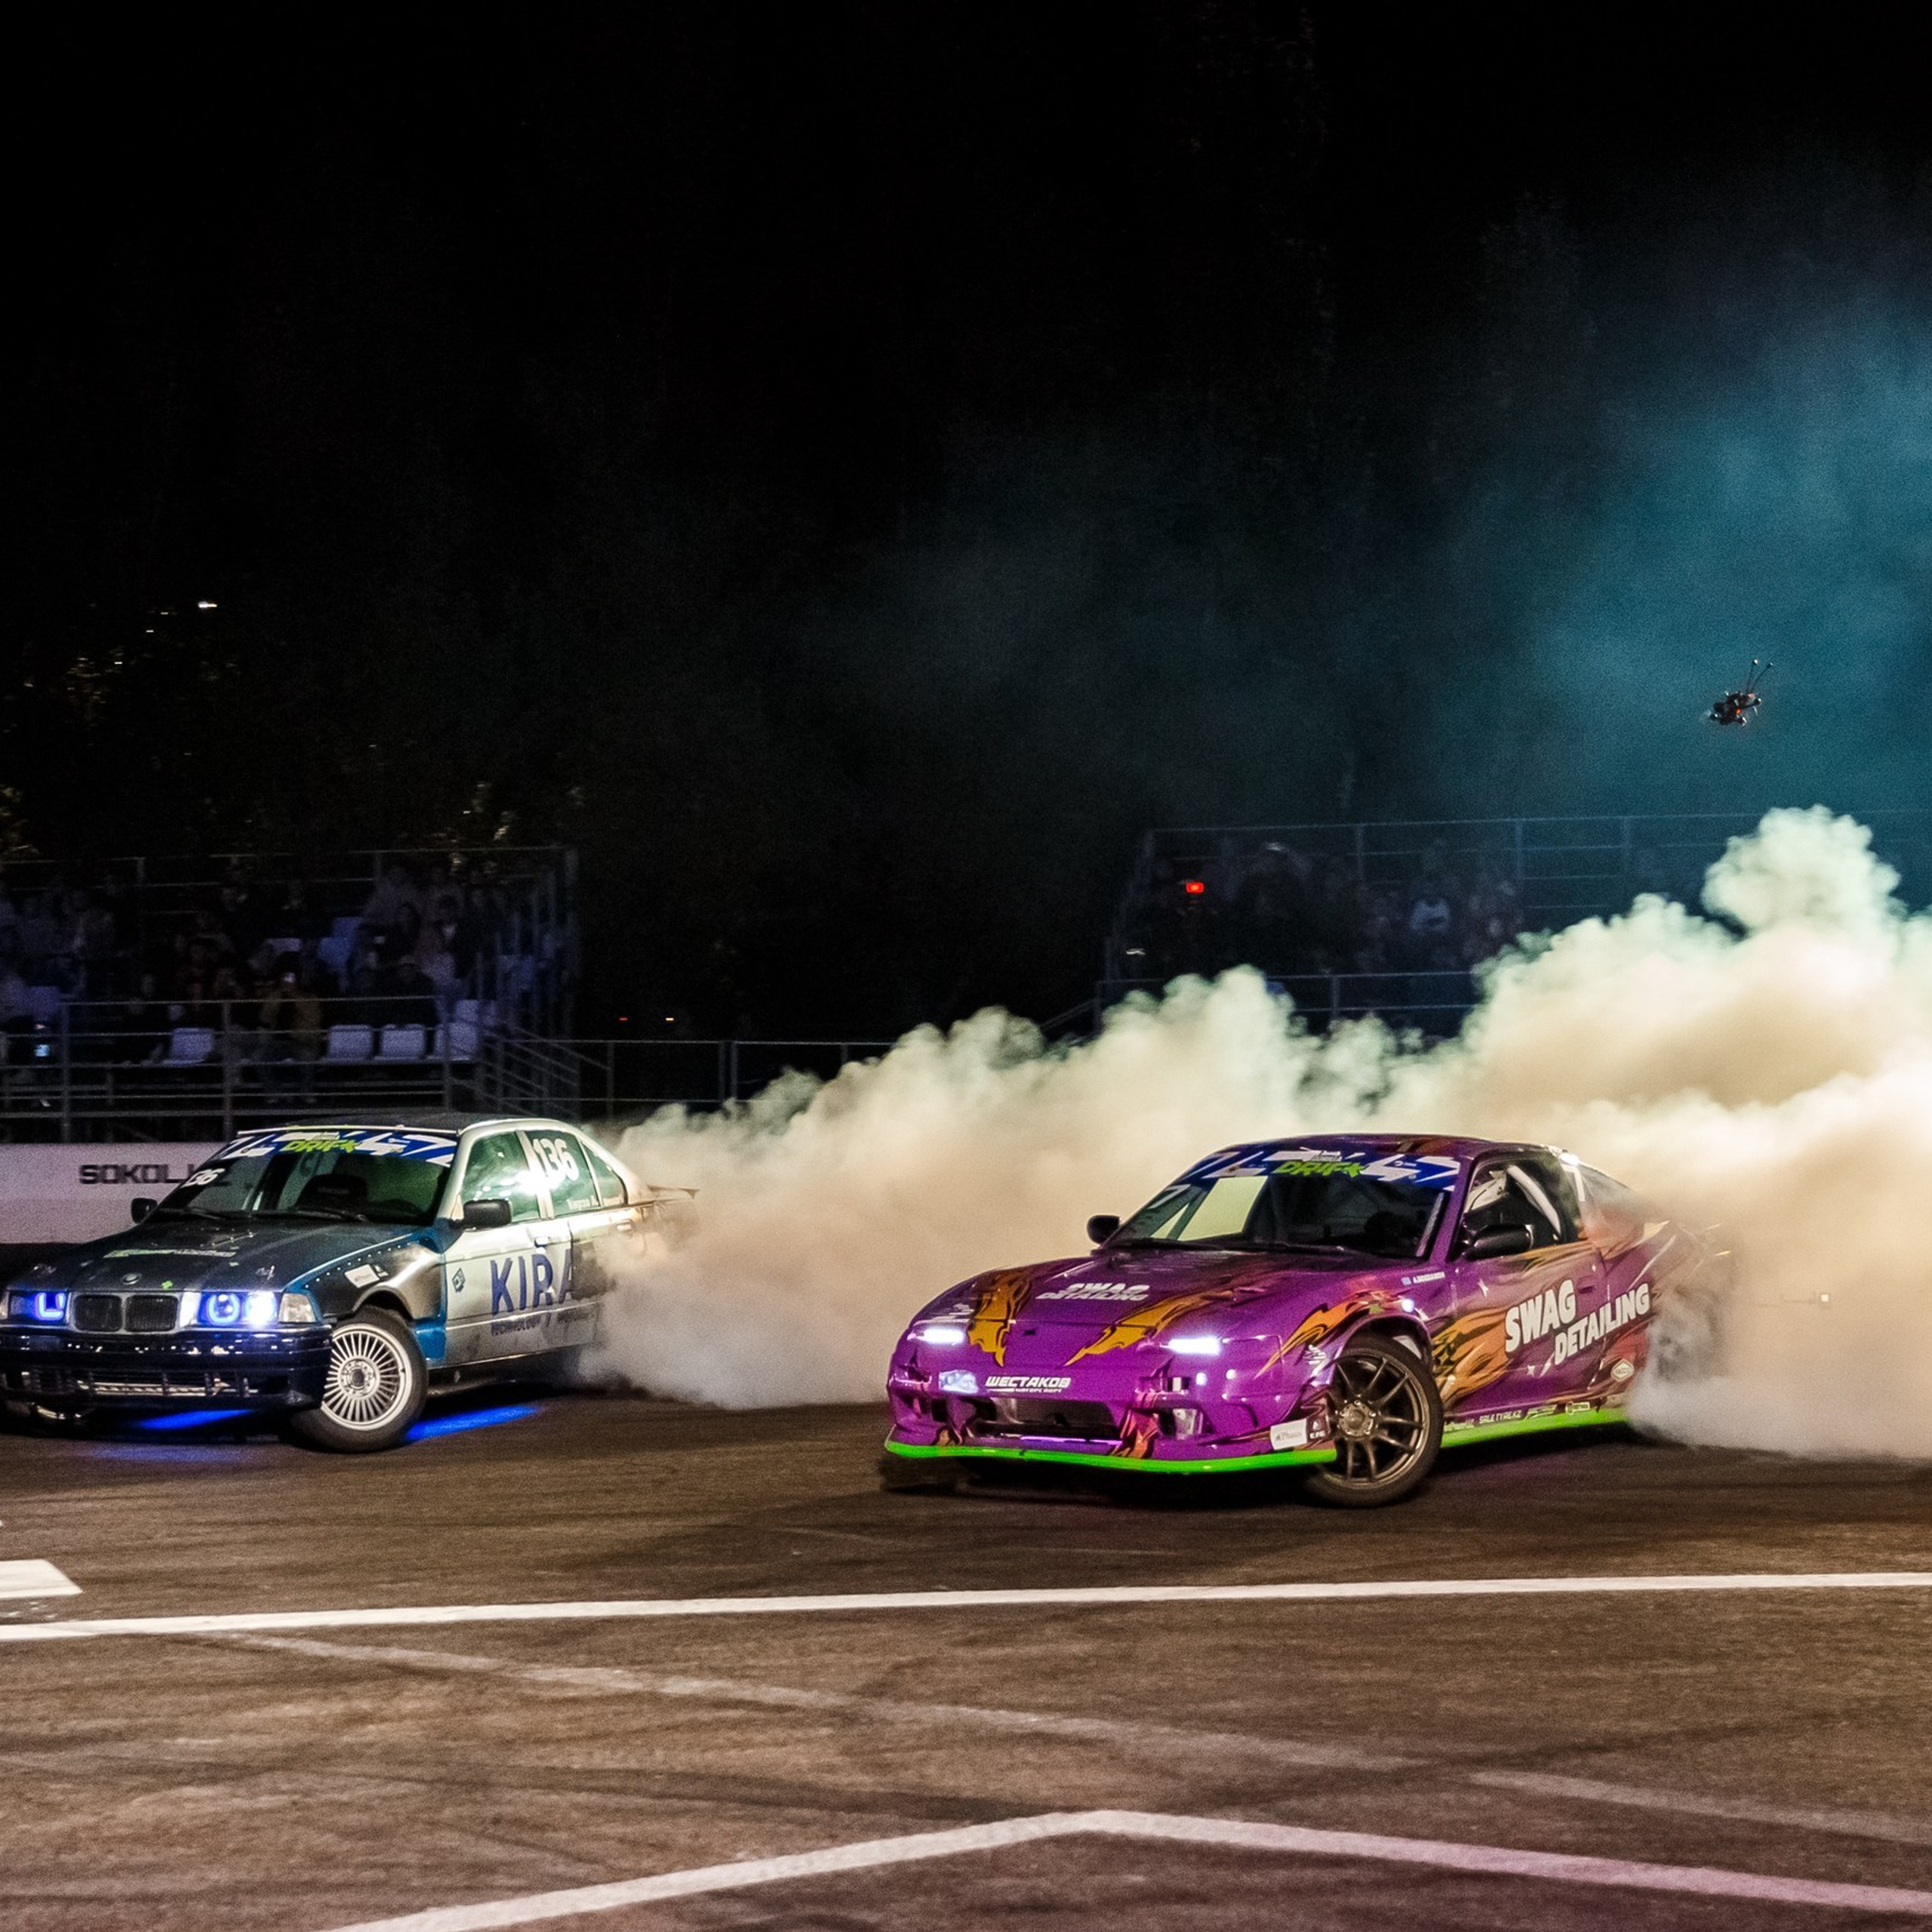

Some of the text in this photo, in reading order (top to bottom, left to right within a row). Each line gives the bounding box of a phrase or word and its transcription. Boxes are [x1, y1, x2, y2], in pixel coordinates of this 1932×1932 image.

[533, 1138, 579, 1188] 136
[1505, 1279, 1576, 1352] SWAG
[1555, 1282, 1650, 1365] DETAILING
[985, 1376, 1071, 1389] ШЕСТАКОВ
